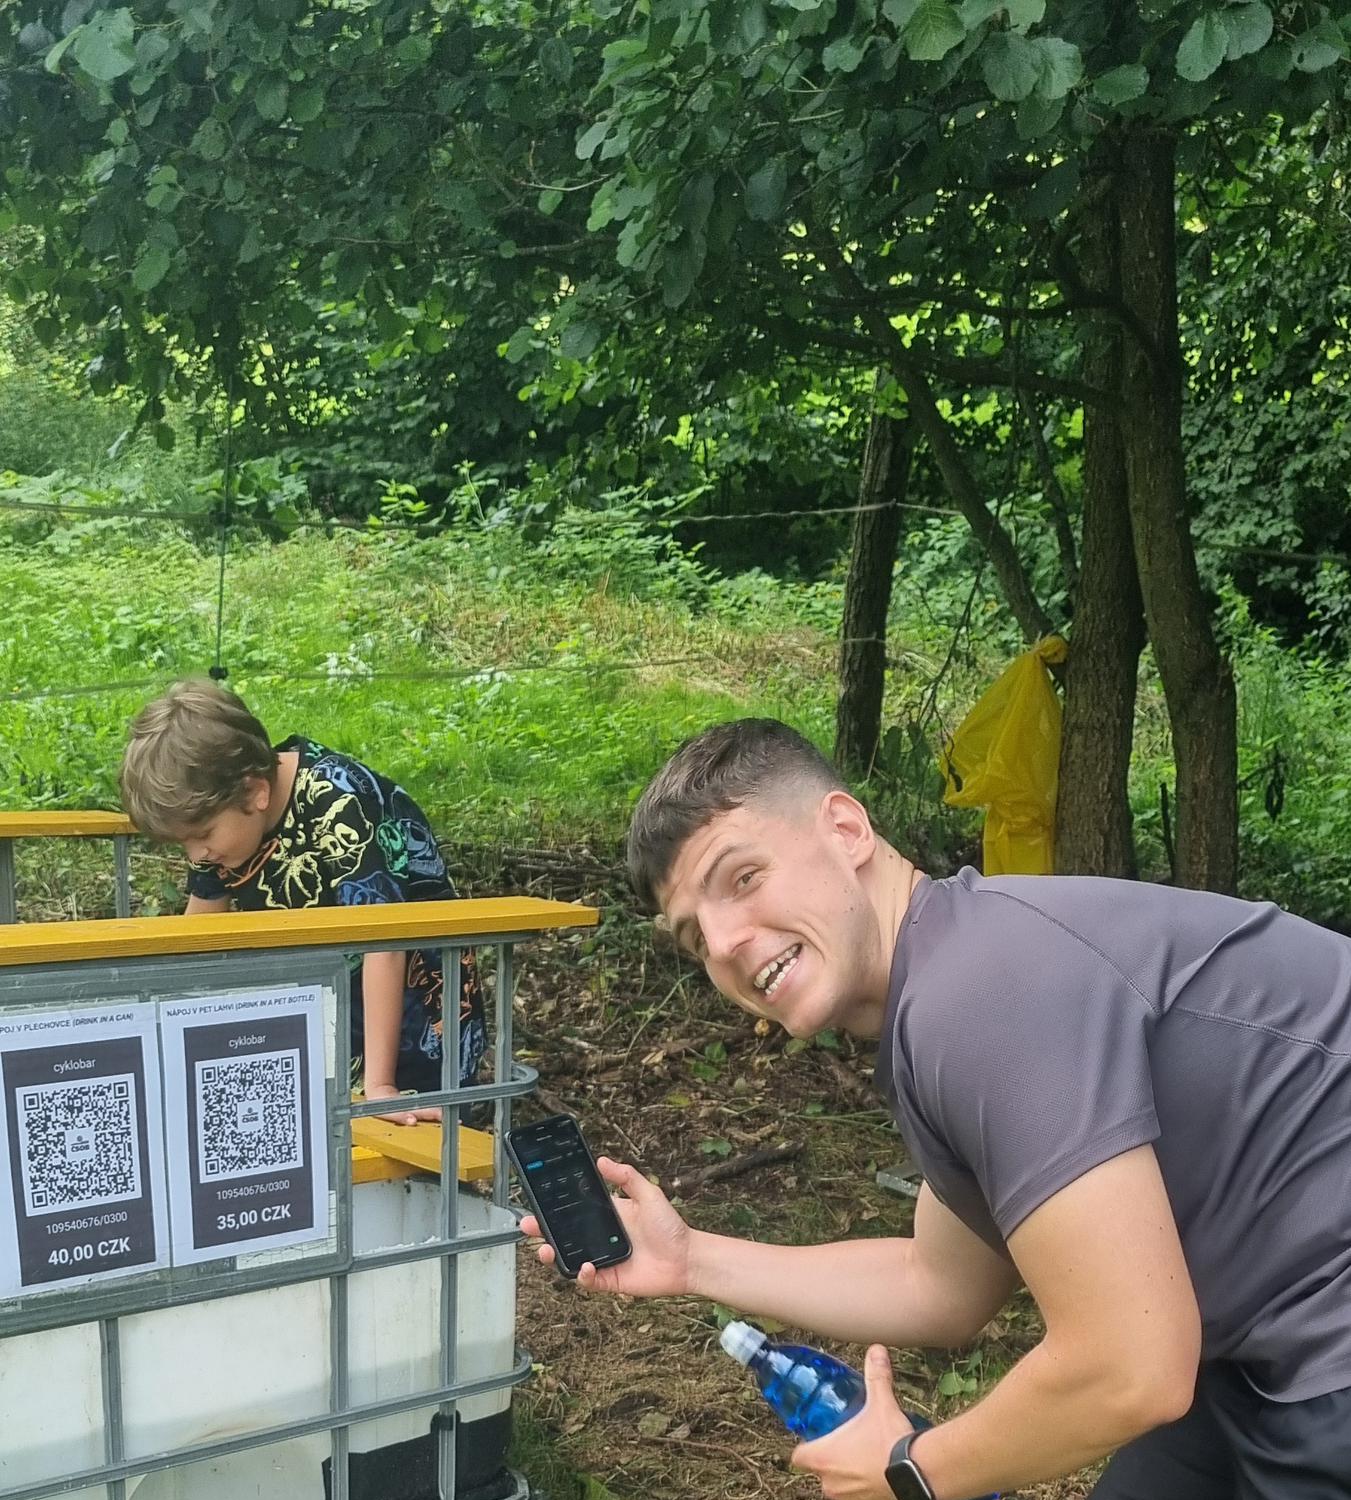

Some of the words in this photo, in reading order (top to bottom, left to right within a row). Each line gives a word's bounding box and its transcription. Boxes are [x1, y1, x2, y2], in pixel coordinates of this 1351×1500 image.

[200, 1005, 212, 1013] PET
[236, 1001, 259, 1010] (DRINK
[274, 997, 287, 1005] PET
[288, 994, 315, 1003] BOTTLE)
[24, 1020, 71, 1031] PLECHOVCE
[73, 1017, 98, 1026] (DRINK
[115, 1013, 134, 1021] CAN)
[228, 1033, 266, 1049] cyklobar
[53, 1058, 96, 1074] cyklobar
[217, 1180, 290, 1200] 109540676/0300
[46, 1212, 127, 1234] 109540676/0300
[217, 1209, 257, 1230] 35,00
[261, 1204, 291, 1222] CZK
[48, 1243, 93, 1266] 40,00
[97, 1236, 131, 1257] CZK
